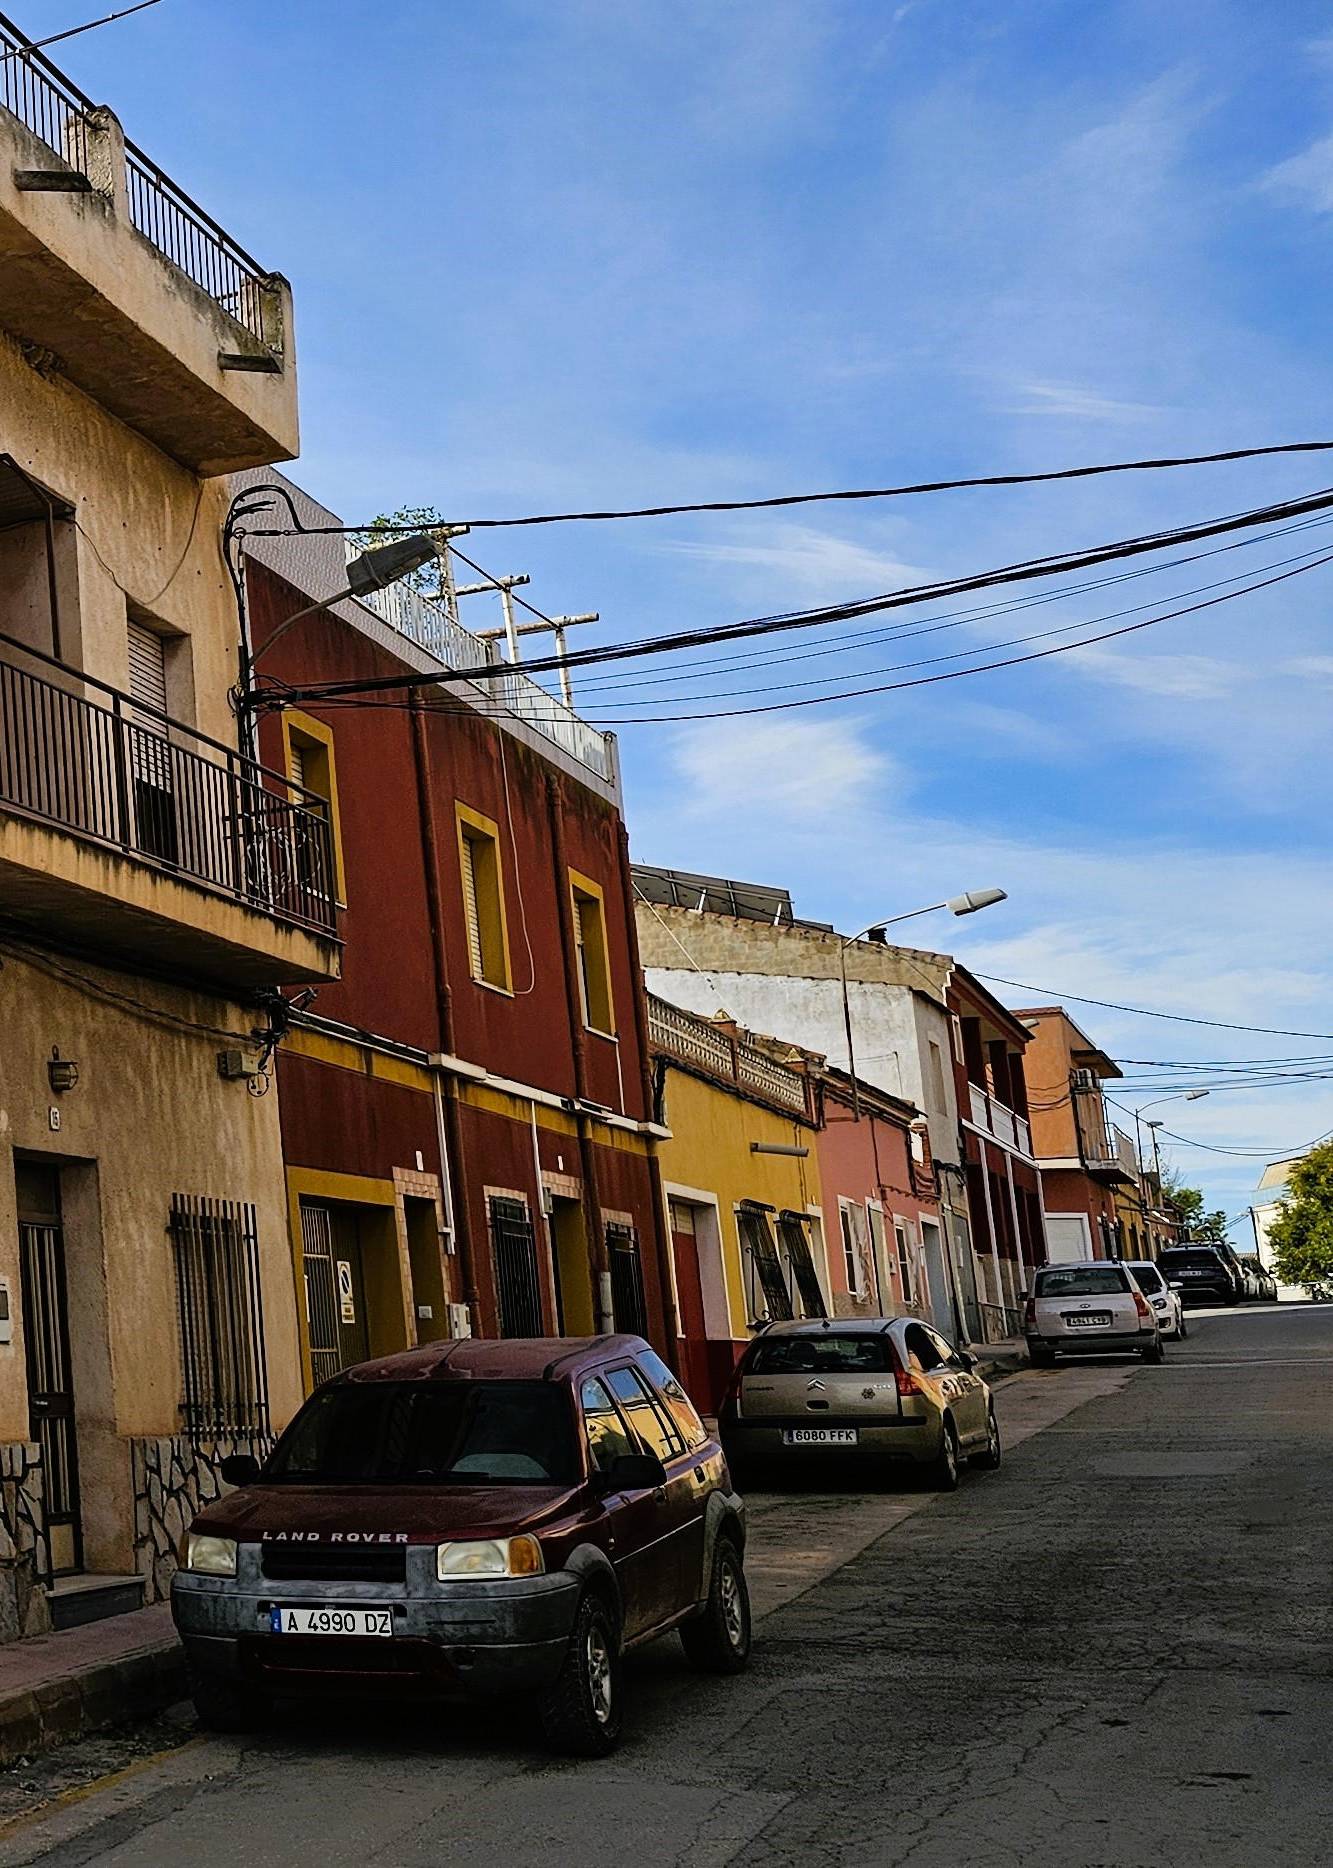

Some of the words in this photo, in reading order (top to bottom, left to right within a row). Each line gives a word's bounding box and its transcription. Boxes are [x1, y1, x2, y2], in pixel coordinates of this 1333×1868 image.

[795, 1430, 826, 1441] 6080
[829, 1430, 854, 1441] FFK
[262, 1531, 320, 1541] LAND
[330, 1532, 409, 1543] ROVER
[287, 1611, 299, 1632] A
[307, 1612, 356, 1633] 4990
[364, 1613, 391, 1634] DZ
